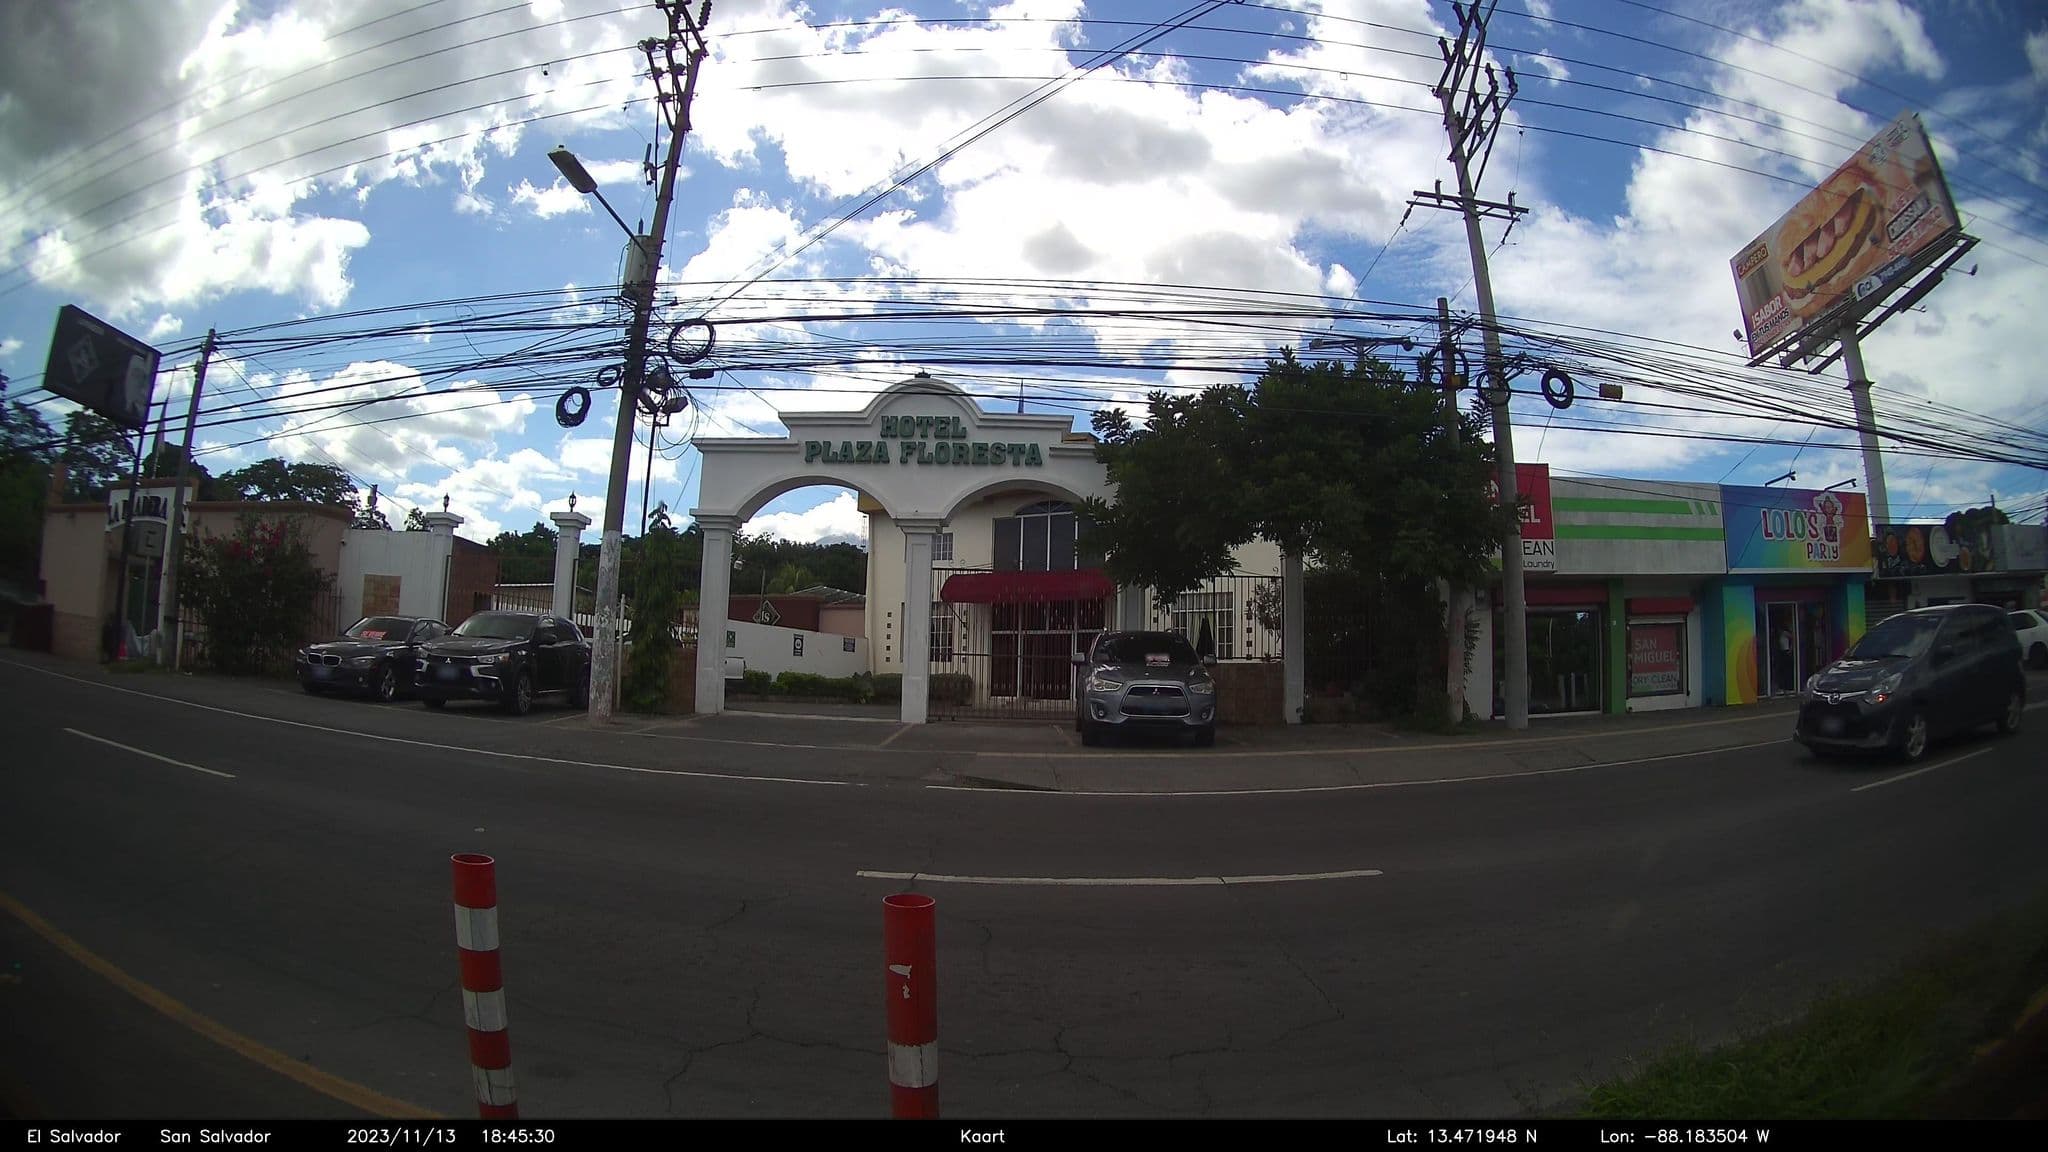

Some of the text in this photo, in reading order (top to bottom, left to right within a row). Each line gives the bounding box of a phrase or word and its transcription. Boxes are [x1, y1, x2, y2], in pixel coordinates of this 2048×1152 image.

[880, 415, 967, 439] HOTEL
[804, 440, 1043, 466] PLAZA FLORESTA
[1762, 509, 1819, 539] LOLO'S
[1523, 541, 1554, 555] EAN
[1807, 542, 1838, 559] PARTY
[1523, 560, 1554, 569] Laundry
[1634, 639, 1657, 650] SAN
[1633, 651, 1674, 664] MIGUEL
